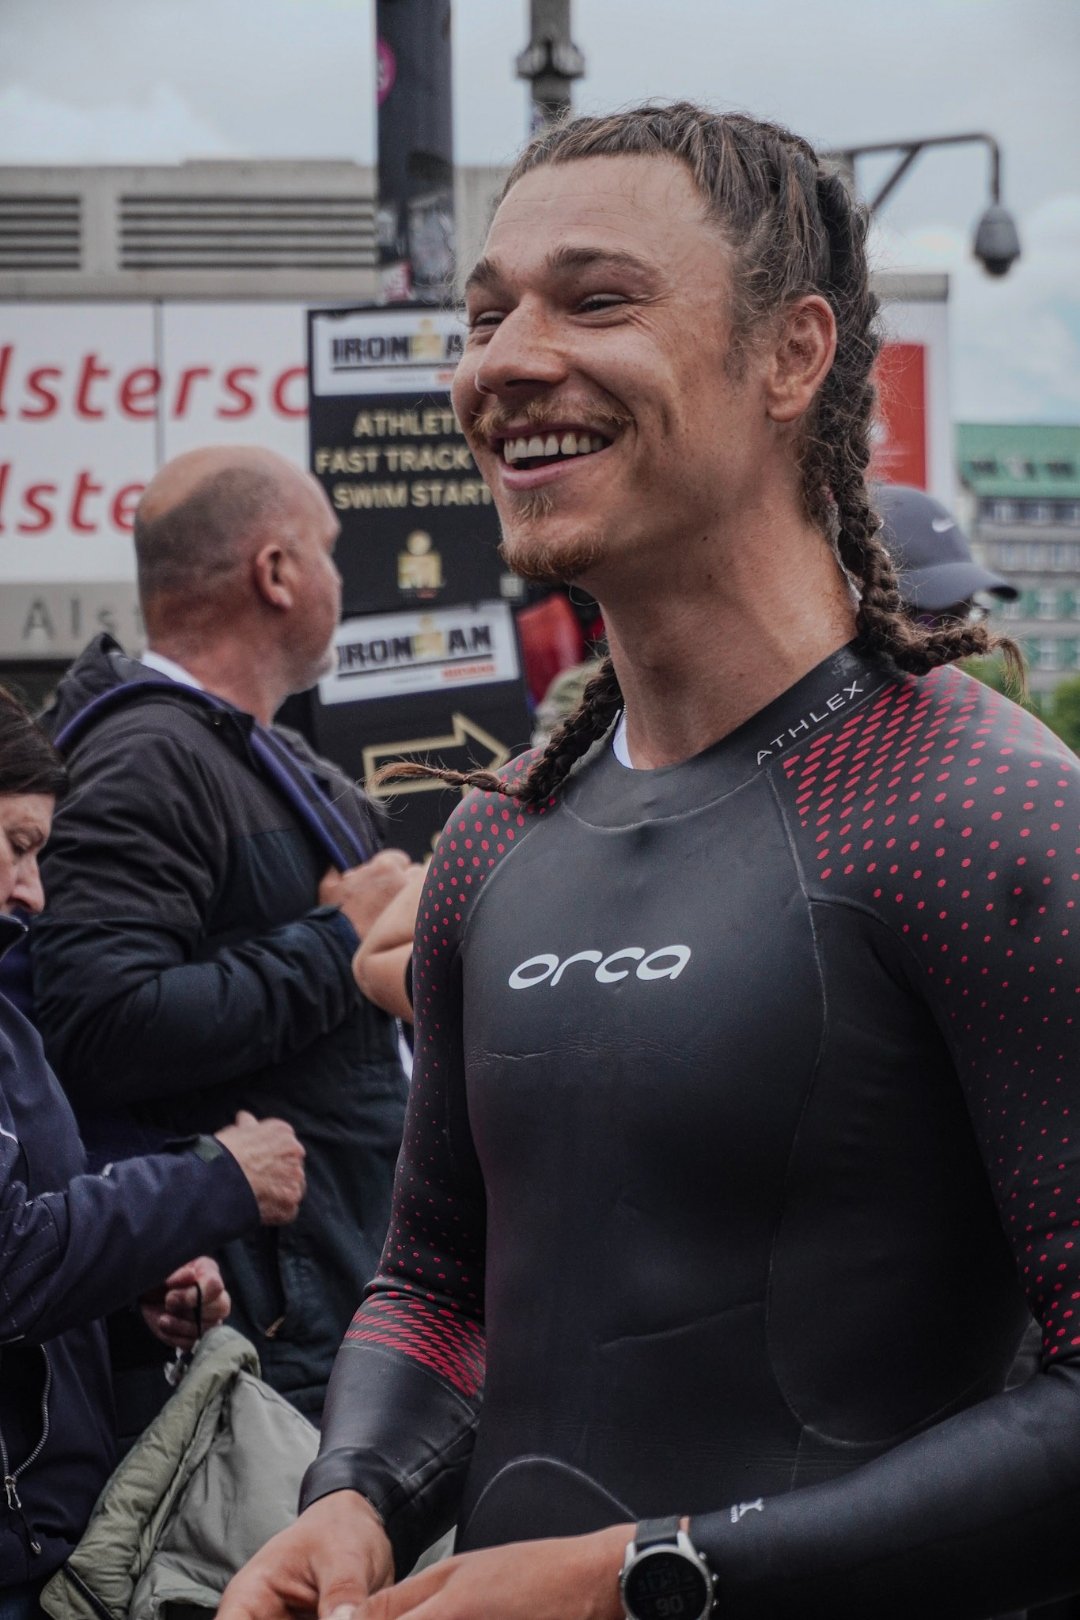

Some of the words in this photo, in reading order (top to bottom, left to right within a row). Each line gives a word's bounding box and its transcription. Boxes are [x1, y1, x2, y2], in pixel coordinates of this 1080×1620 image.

[315, 447, 377, 474] FAST
[384, 445, 472, 472] TRACK
[333, 481, 407, 509] SWIM
[412, 479, 492, 506] START
[757, 680, 864, 765] ATHLEX
[508, 944, 691, 990] orca
